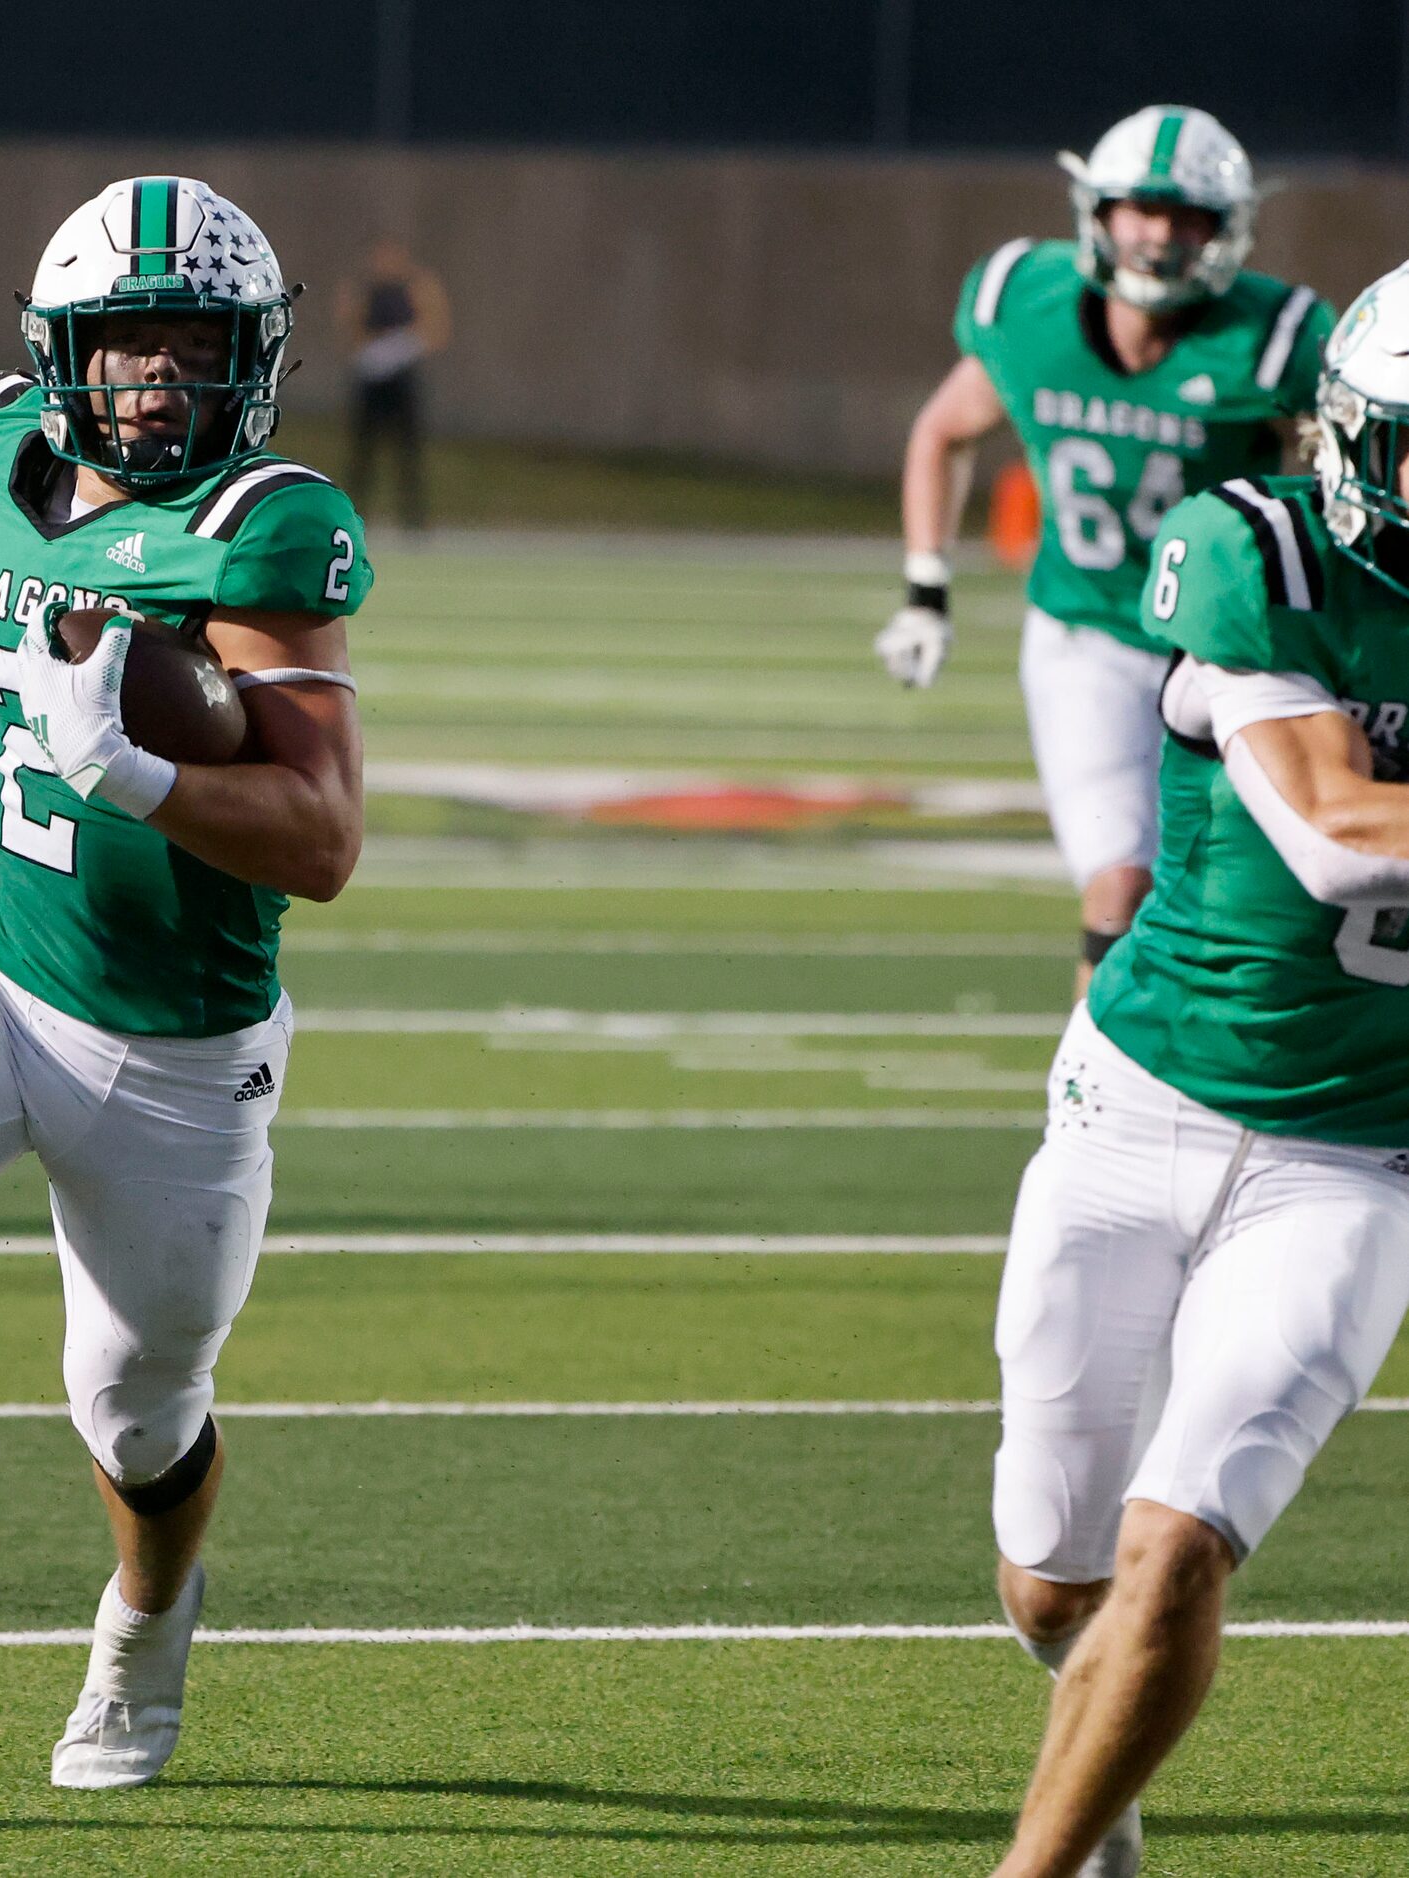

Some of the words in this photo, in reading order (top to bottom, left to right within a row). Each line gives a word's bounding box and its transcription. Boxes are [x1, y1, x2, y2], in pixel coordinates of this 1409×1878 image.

[119, 275, 184, 292] DRAGONS
[1049, 436, 1185, 571] 64
[106, 546, 146, 574] adidas
[324, 527, 354, 602] 2
[1153, 538, 1187, 622] 6
[234, 1082, 275, 1102] adidas
